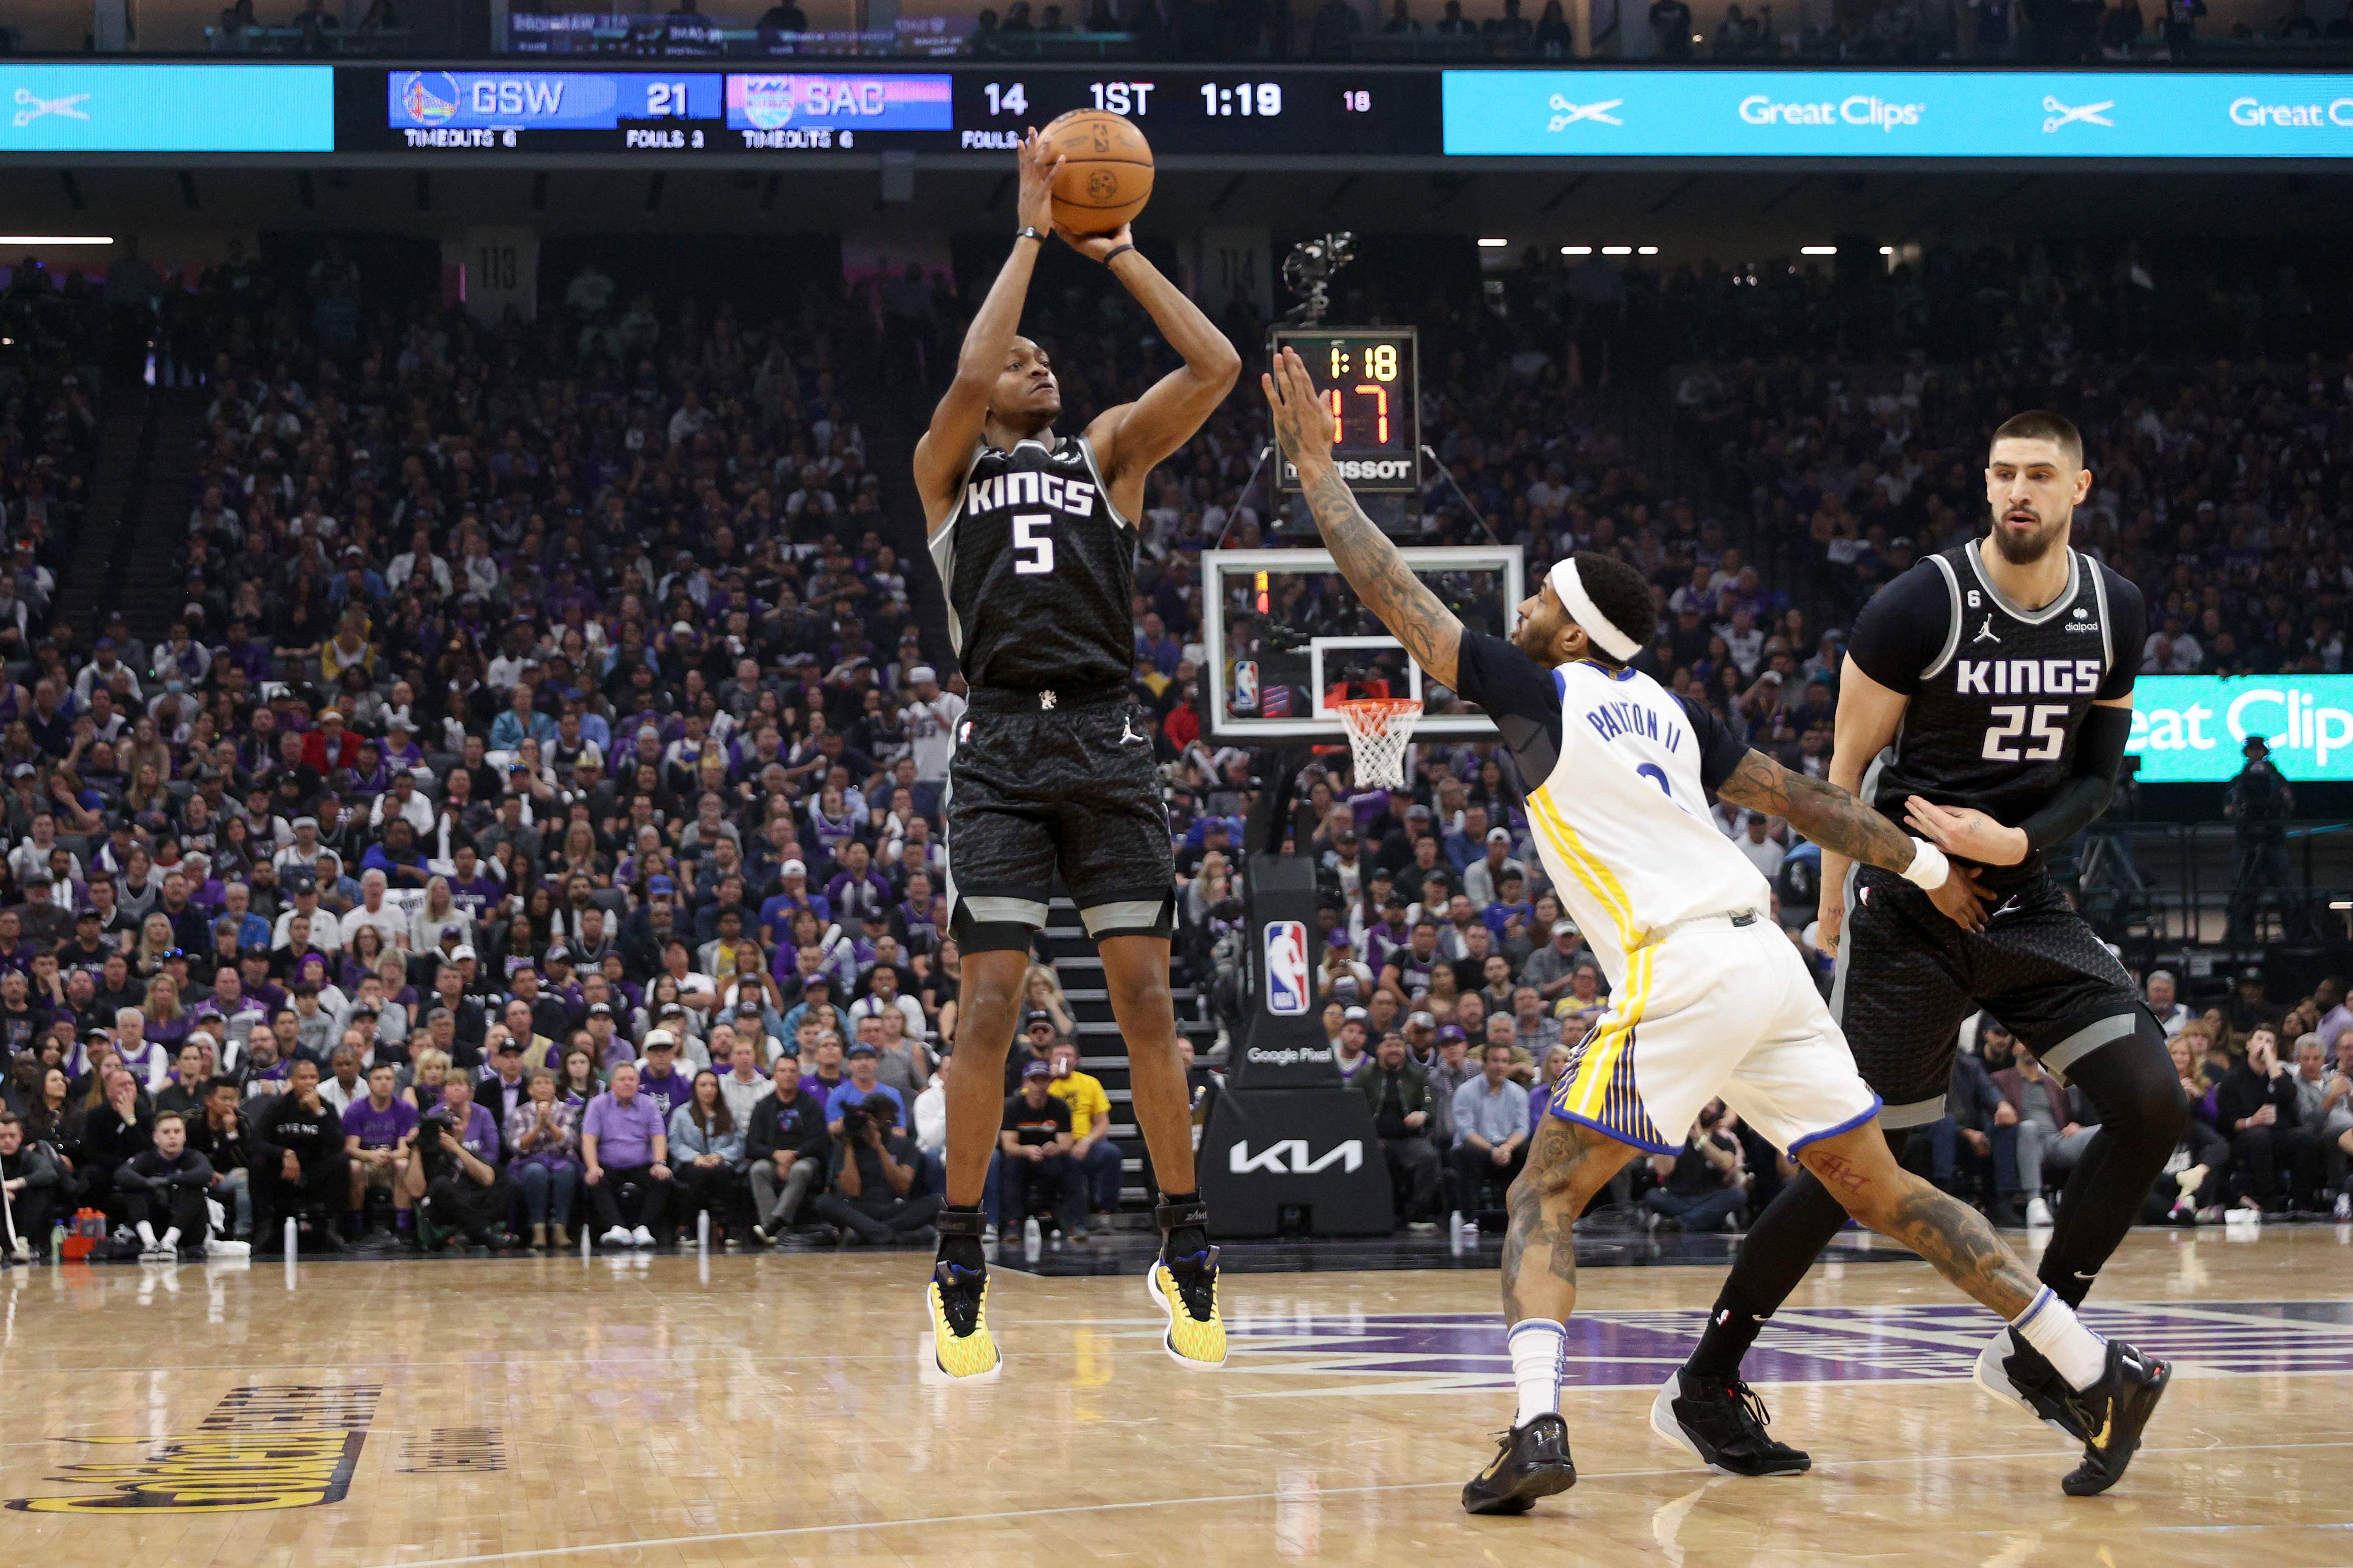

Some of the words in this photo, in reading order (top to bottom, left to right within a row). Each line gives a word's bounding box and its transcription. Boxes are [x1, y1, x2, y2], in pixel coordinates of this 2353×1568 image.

[472, 80, 564, 115] GSW
[646, 82, 687, 116] 21
[806, 81, 885, 116] SAC
[984, 82, 1029, 116] 14
[1090, 81, 1155, 116] 1ST
[1200, 82, 1282, 116] 1:19
[1738, 94, 1837, 125] Great
[1839, 94, 1921, 133] Clips
[2229, 96, 2325, 127] Great
[403, 129, 494, 148] TIMEOUTS
[626, 130, 685, 148] FOULS
[742, 130, 832, 149] TIMEOUTS
[961, 130, 1019, 149] FOULS
[1331, 344, 1398, 382] 1:18
[1331, 384, 1389, 444] 17
[1333, 460, 1412, 480] ISSOT
[968, 471, 1095, 517] KINGS
[1012, 514, 1055, 574] 5
[1967, 589, 1981, 608] 6
[2065, 621, 2098, 633] dialpad
[1956, 659, 2101, 694] KINGS
[1586, 701, 1658, 742] PAYTON
[1664, 719, 1682, 754] II
[1981, 704, 2070, 762] 25
[1247, 1046, 1300, 1066] Google
[1300, 1046, 1333, 1063] Pixel
[1229, 1138, 1364, 1174] KIA
[195, 1384, 384, 1430] CENTER
